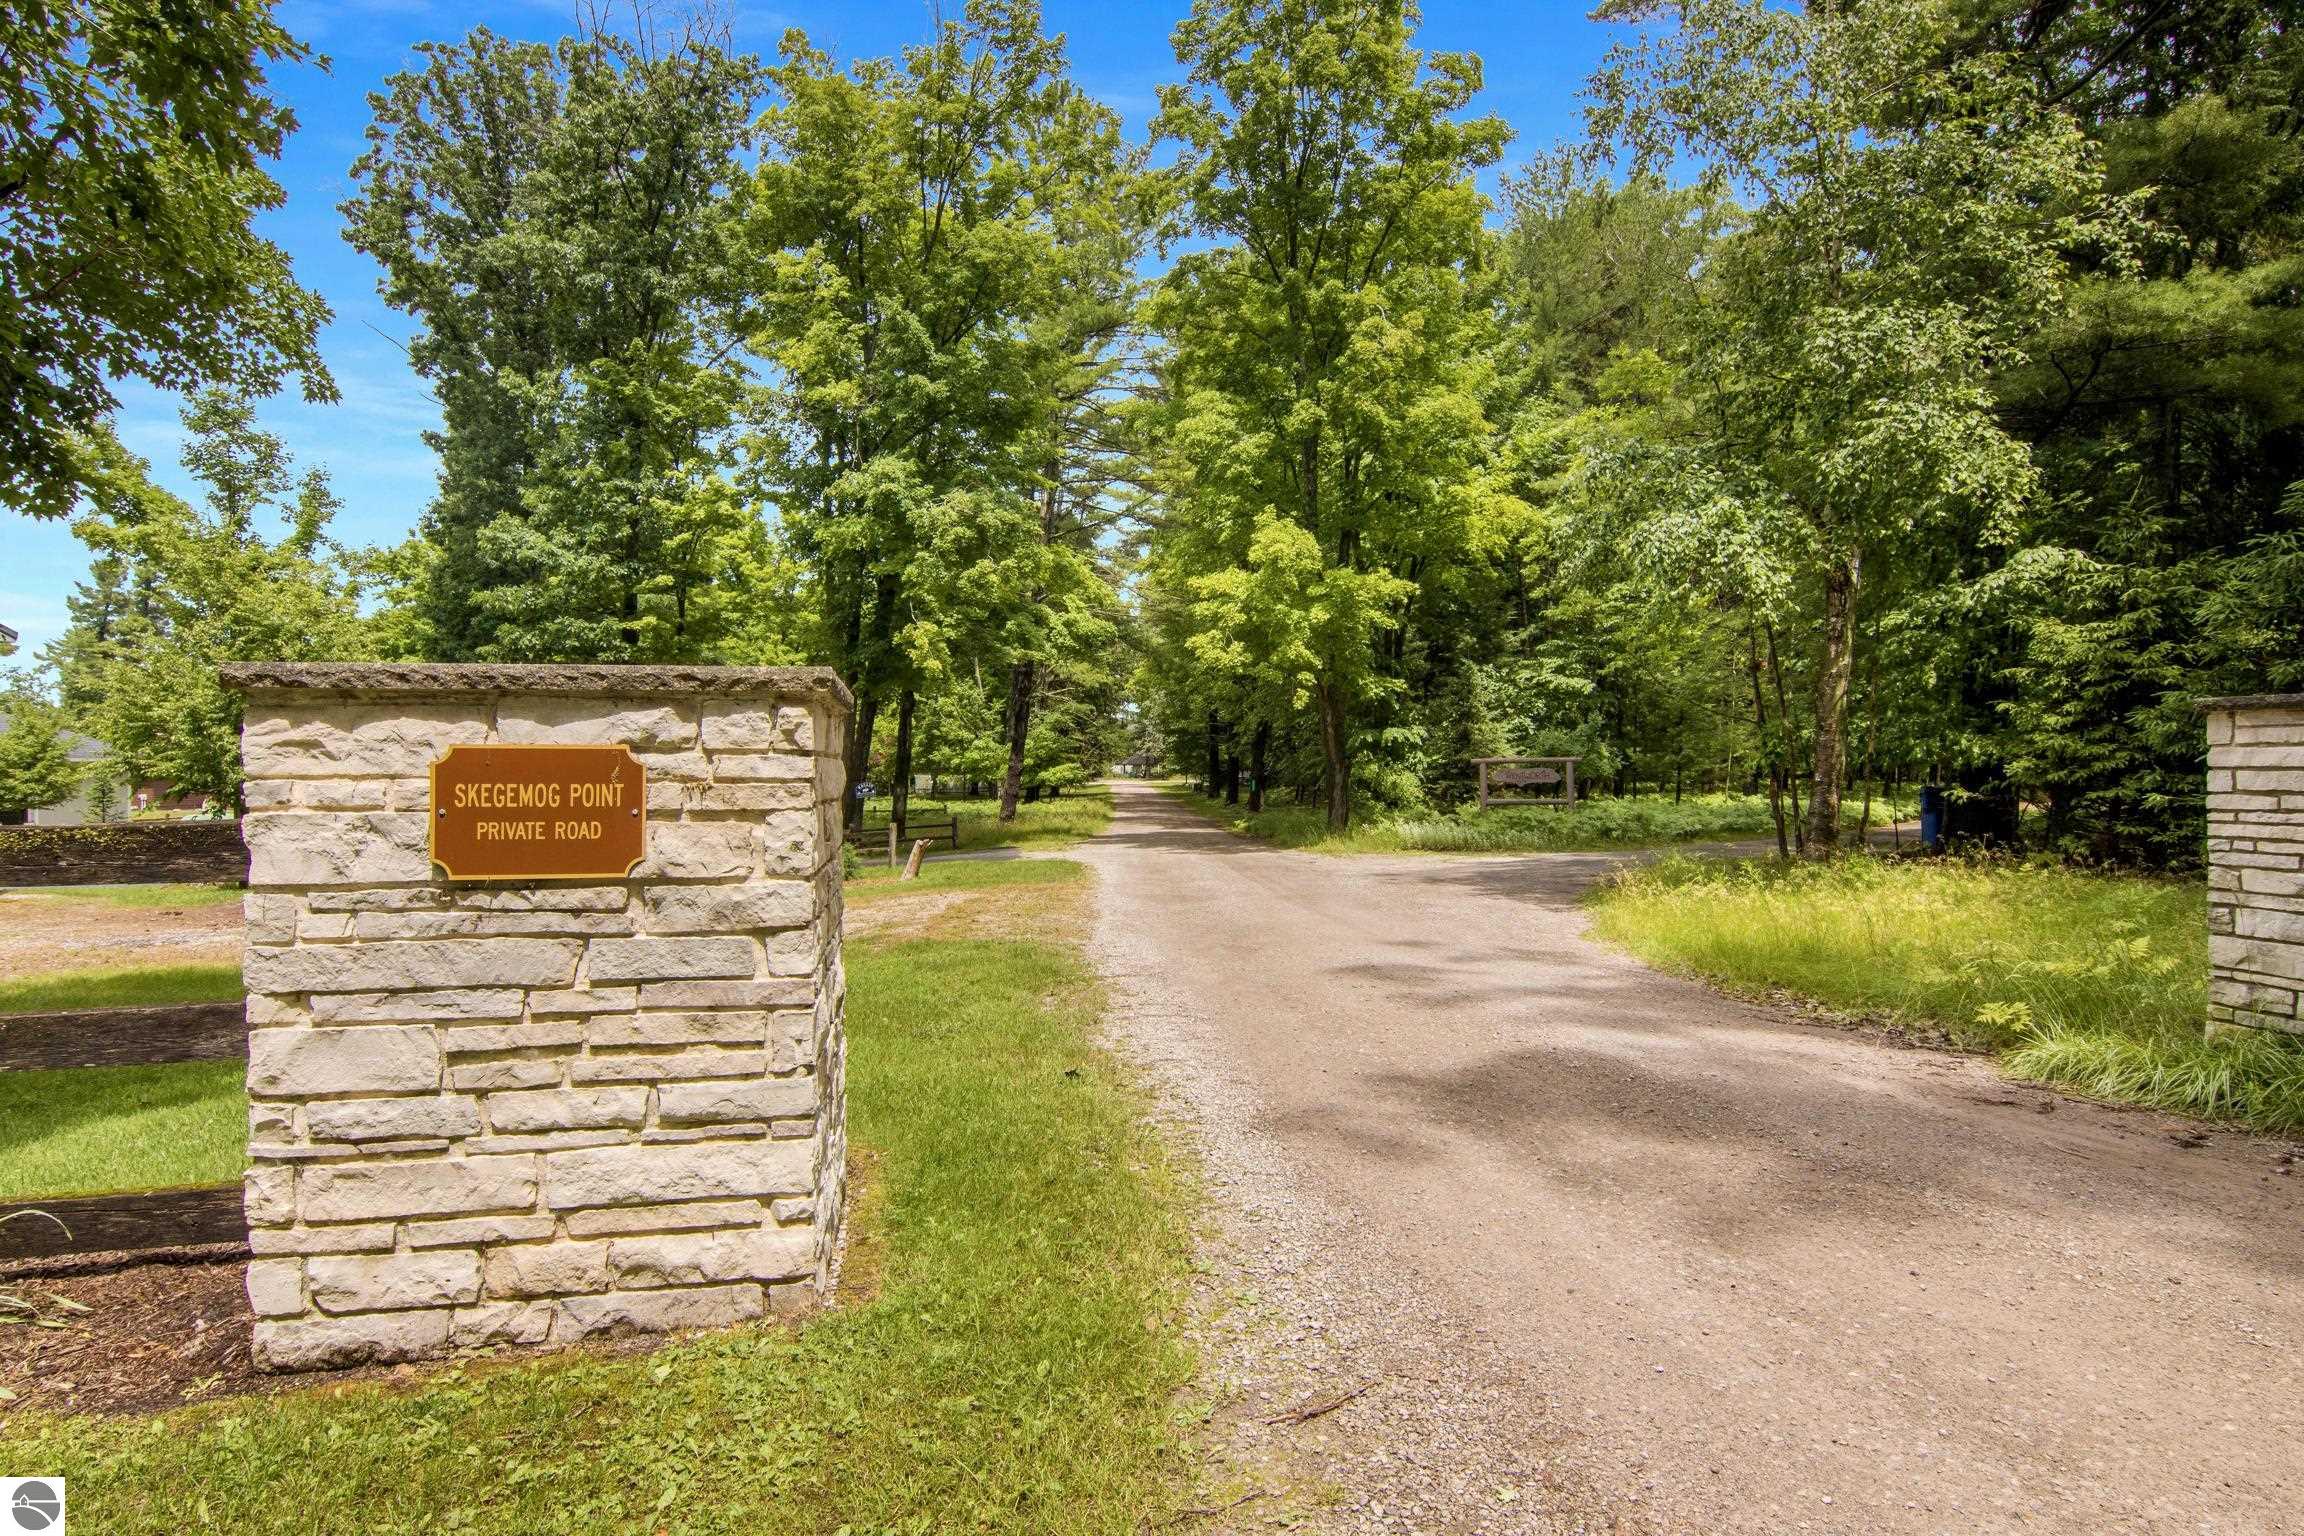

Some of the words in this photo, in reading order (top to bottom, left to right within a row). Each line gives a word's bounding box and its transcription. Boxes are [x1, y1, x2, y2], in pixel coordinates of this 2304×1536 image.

[454, 783, 561, 808] SKEGEMOG
[570, 783, 625, 808] POINT
[476, 821, 546, 840] PRIVATE
[554, 821, 602, 840] ROAD
